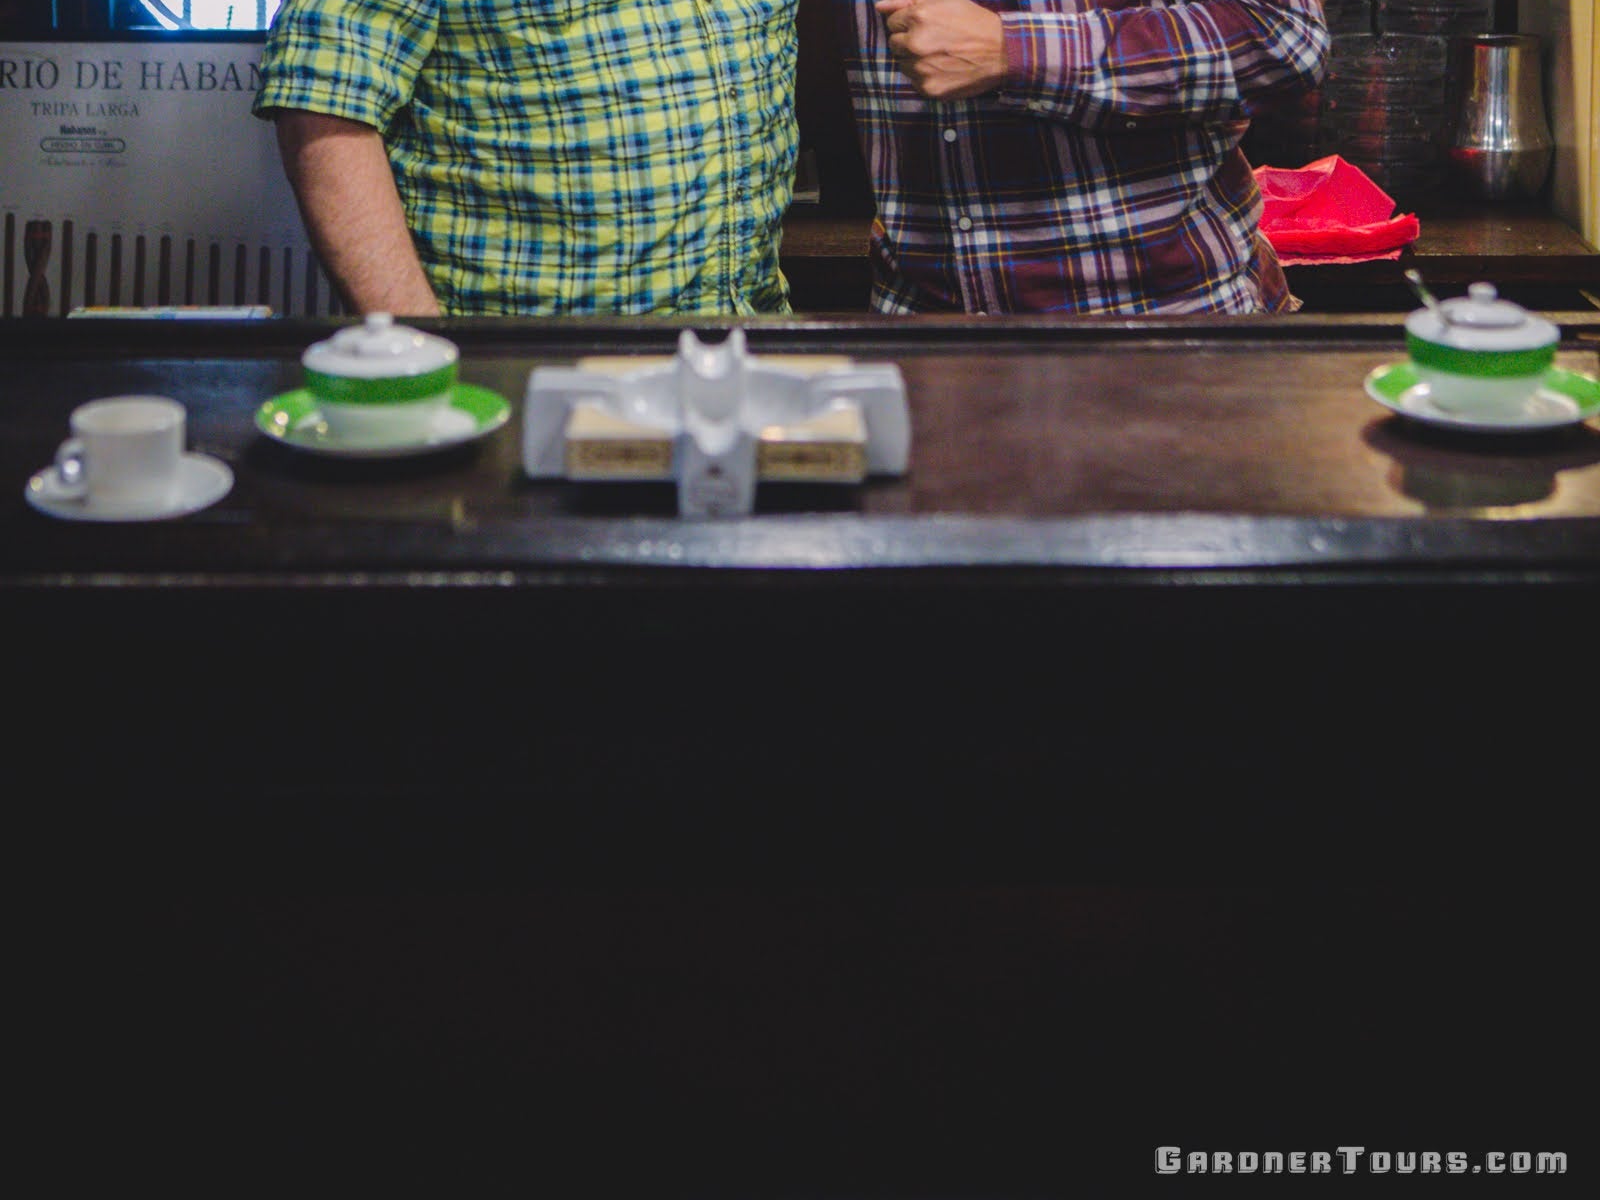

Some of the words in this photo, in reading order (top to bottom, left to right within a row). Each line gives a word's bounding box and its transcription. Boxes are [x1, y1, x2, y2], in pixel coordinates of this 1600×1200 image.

[0, 60, 59, 90] RIO
[75, 60, 123, 90] DE
[31, 102, 79, 116] TRIPA
[86, 103, 140, 117] LARGA
